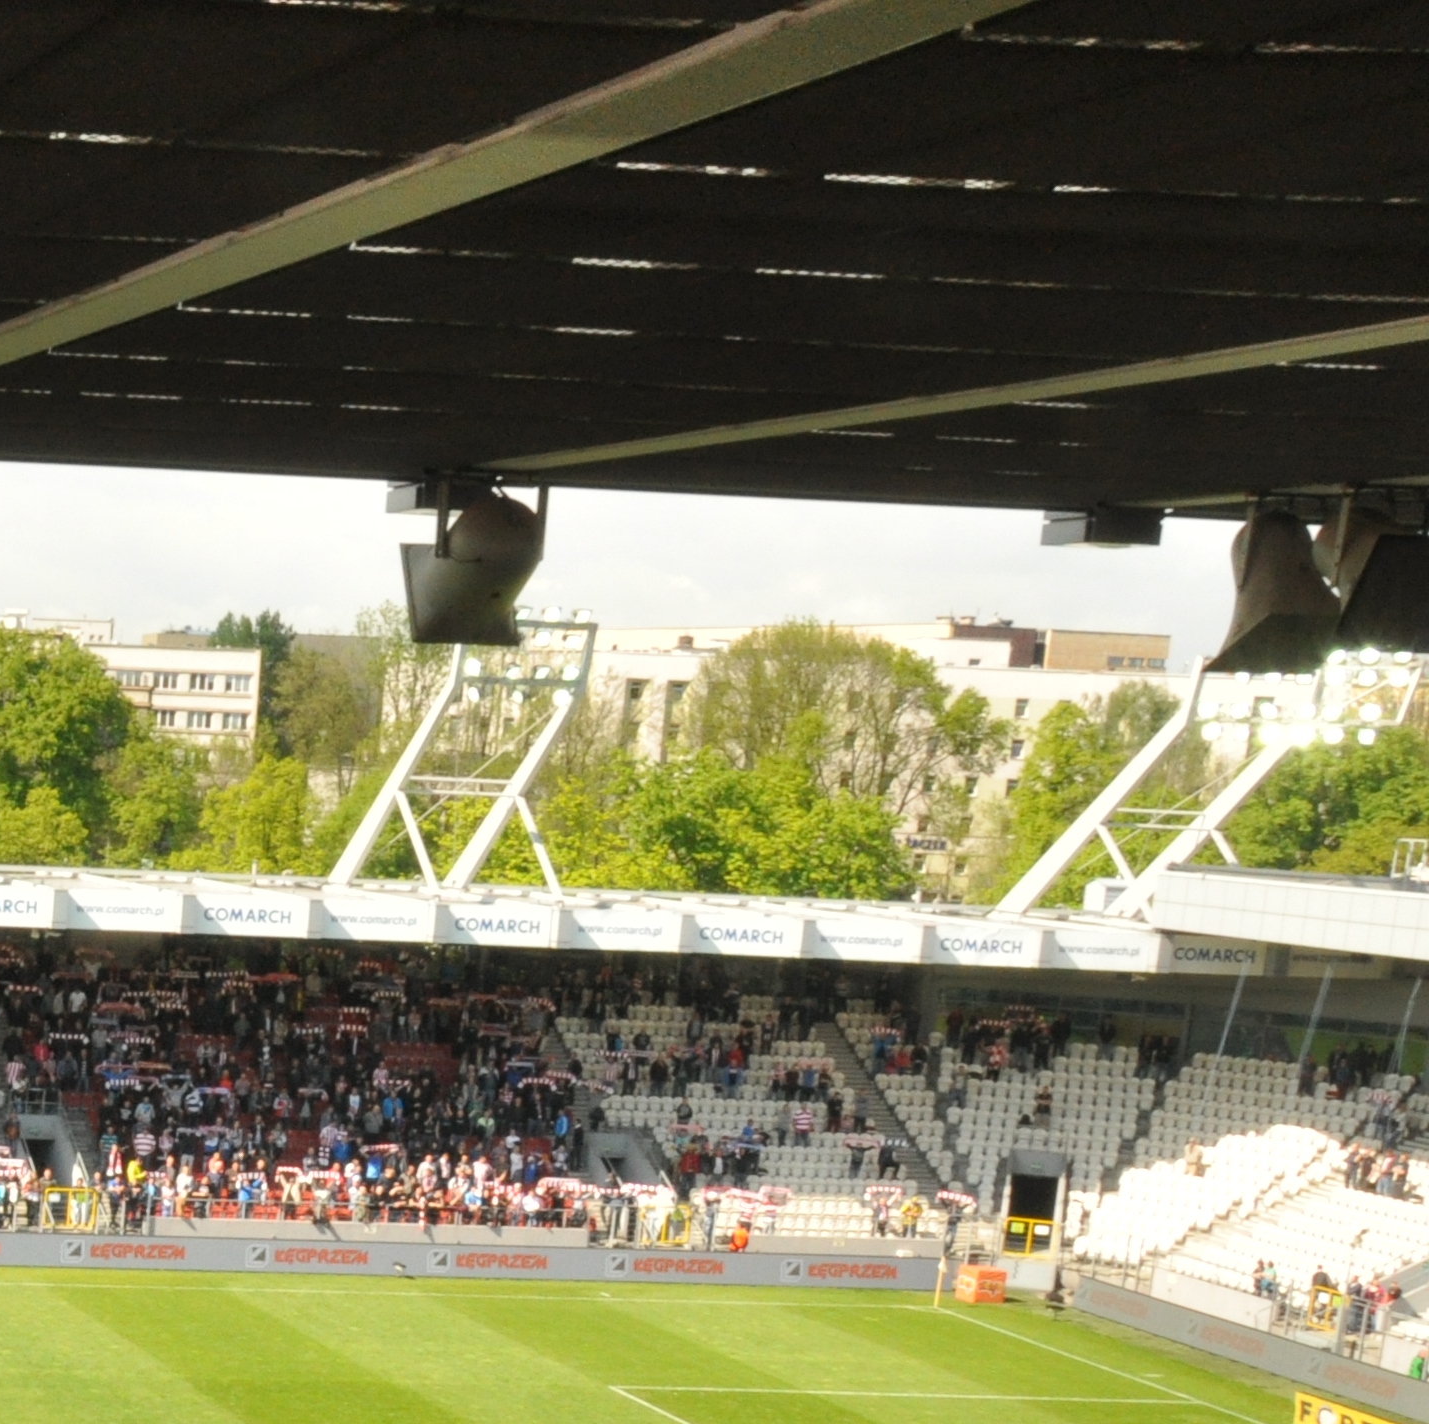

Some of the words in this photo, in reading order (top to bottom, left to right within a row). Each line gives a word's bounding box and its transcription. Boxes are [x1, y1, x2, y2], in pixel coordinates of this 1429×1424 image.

[204, 907, 291, 924] COMARCH
[455, 917, 540, 934] COMARCH
[699, 927, 783, 944] COMARCH
[940, 937, 1022, 954] COMARCH
[1174, 947, 1255, 964] COMARCH
